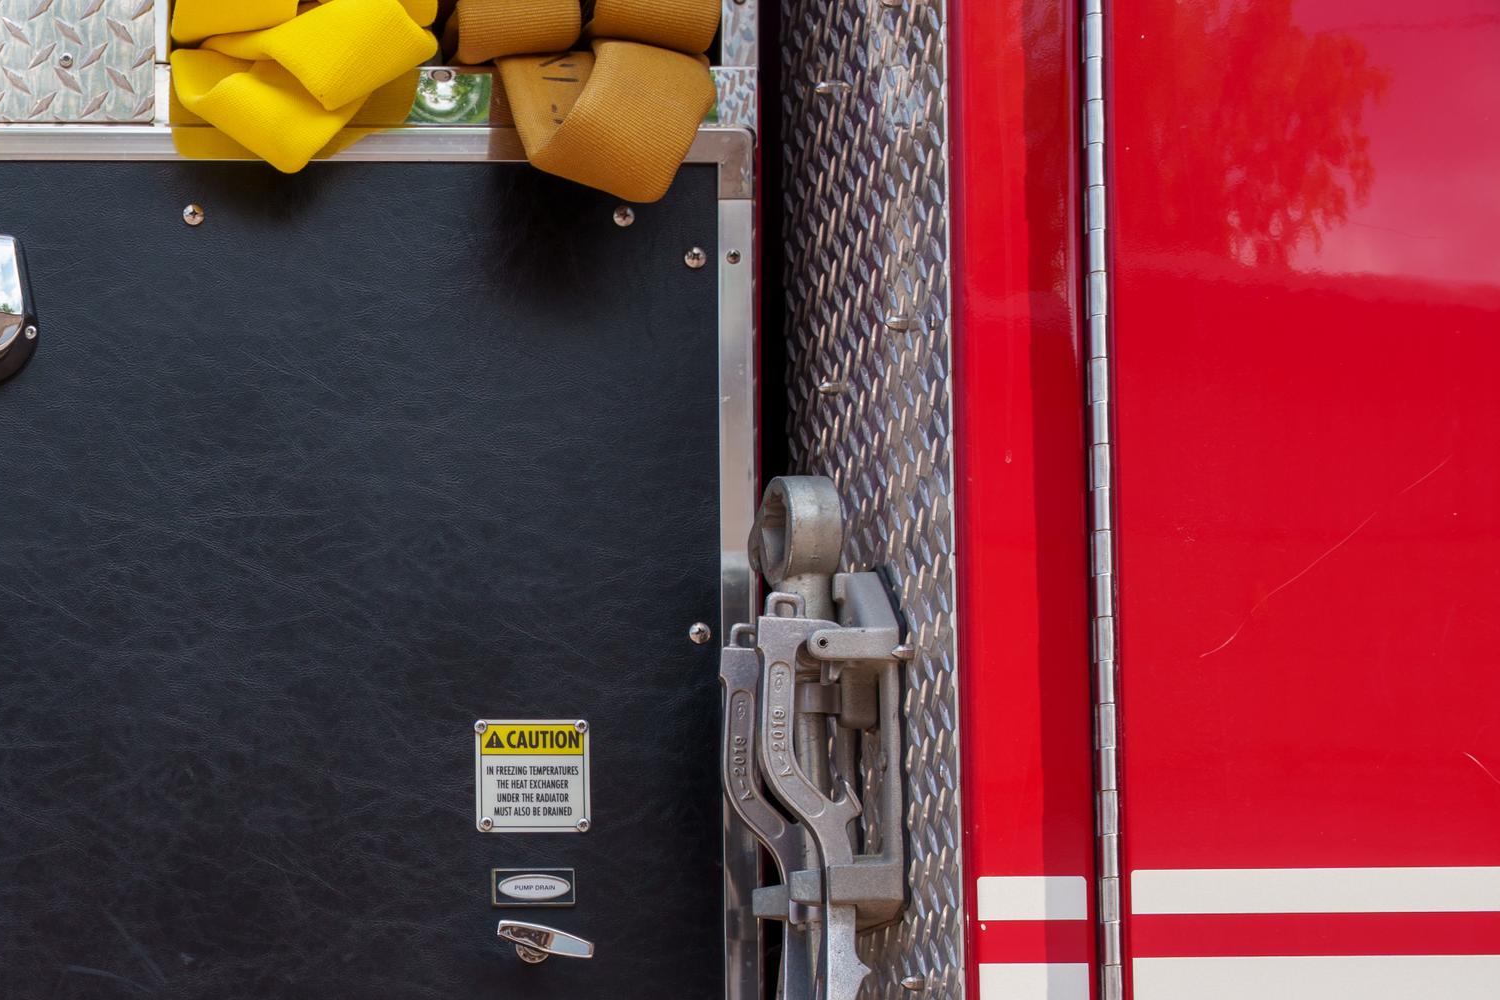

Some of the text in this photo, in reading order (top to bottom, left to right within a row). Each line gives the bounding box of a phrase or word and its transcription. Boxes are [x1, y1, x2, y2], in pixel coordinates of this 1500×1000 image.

[506, 730, 580, 749] CAUTION
[486, 766, 579, 775] IN FREEZING TEMPERATURES
[496, 780, 569, 789] THE HEAT EXCHANGER
[497, 793, 569, 802] UNDER THE RADIATOR
[494, 806, 572, 816] MUST ALSO BE DRAINED
